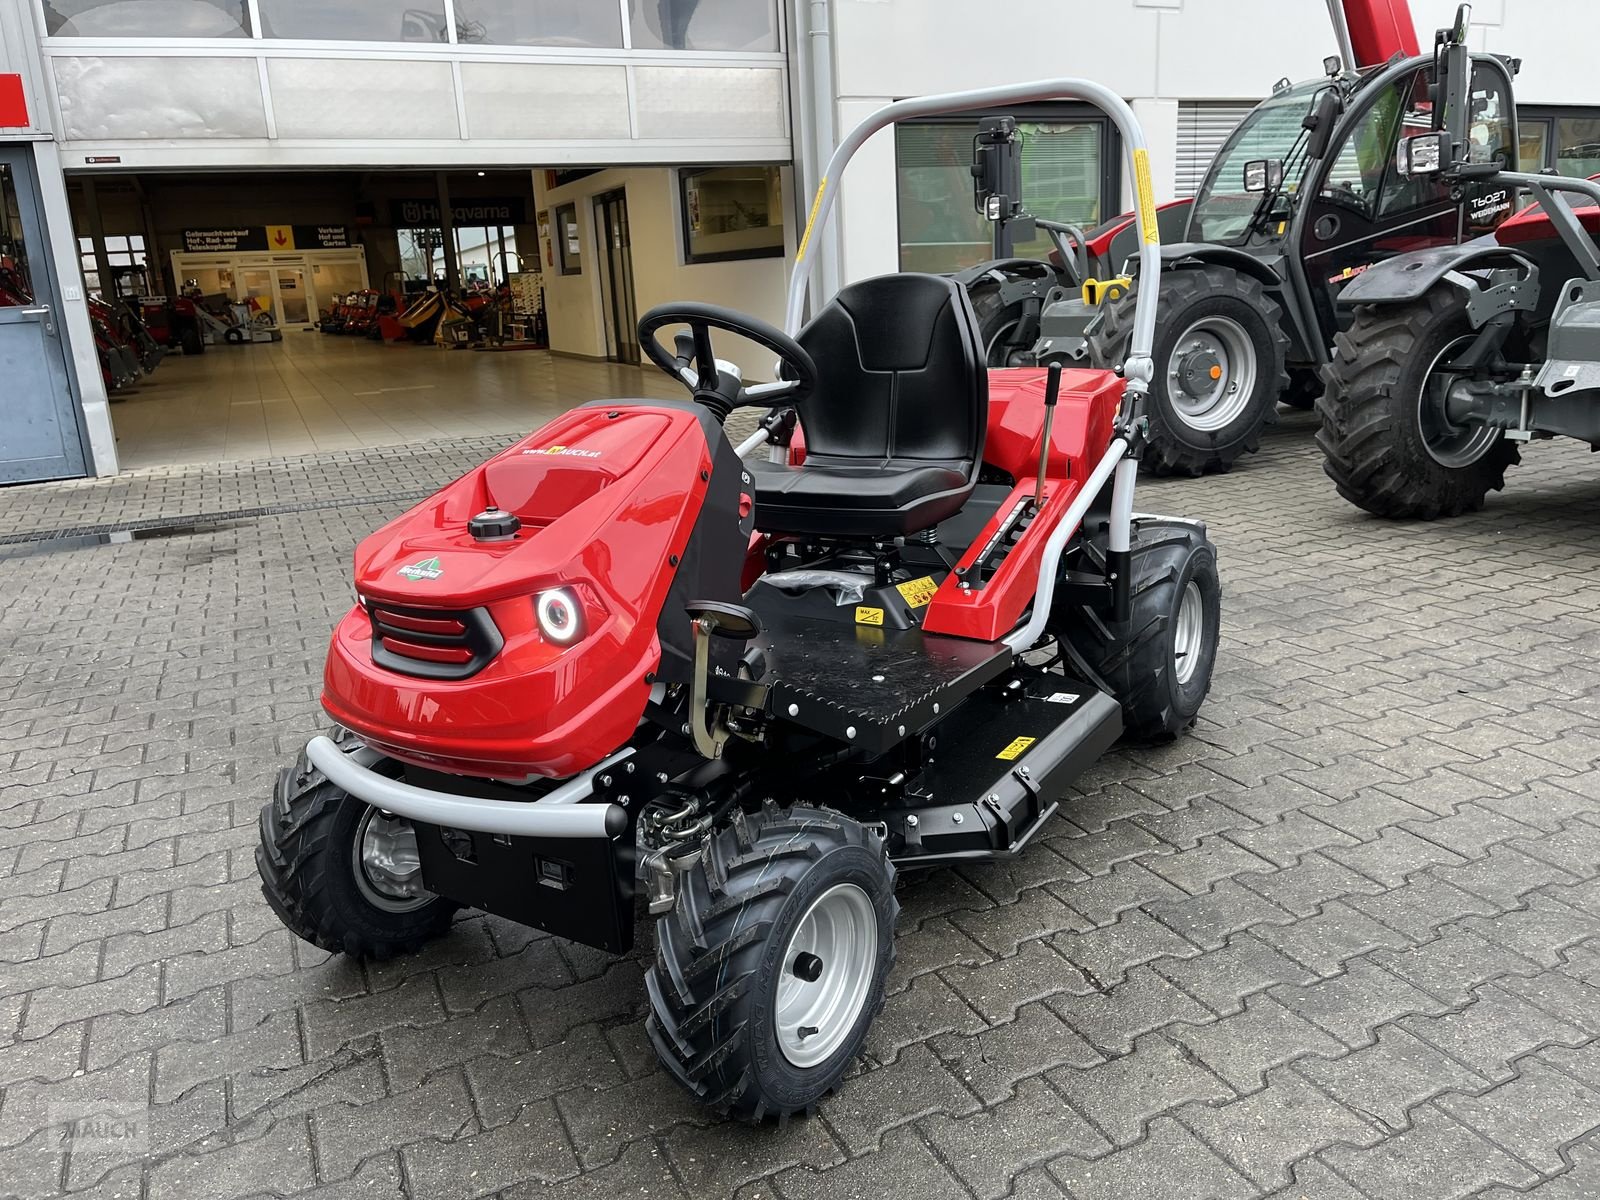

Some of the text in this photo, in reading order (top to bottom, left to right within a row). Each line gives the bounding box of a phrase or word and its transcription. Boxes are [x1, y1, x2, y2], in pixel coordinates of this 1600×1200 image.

[1470, 190, 1506, 208] T6027
[1470, 201, 1510, 220] WEIDEMANN
[185, 229, 249, 238] Gebrauchtverkauf
[317, 226, 345, 234] Verkauf
[318, 233, 331, 241] Hof
[323, 239, 347, 247] Garten
